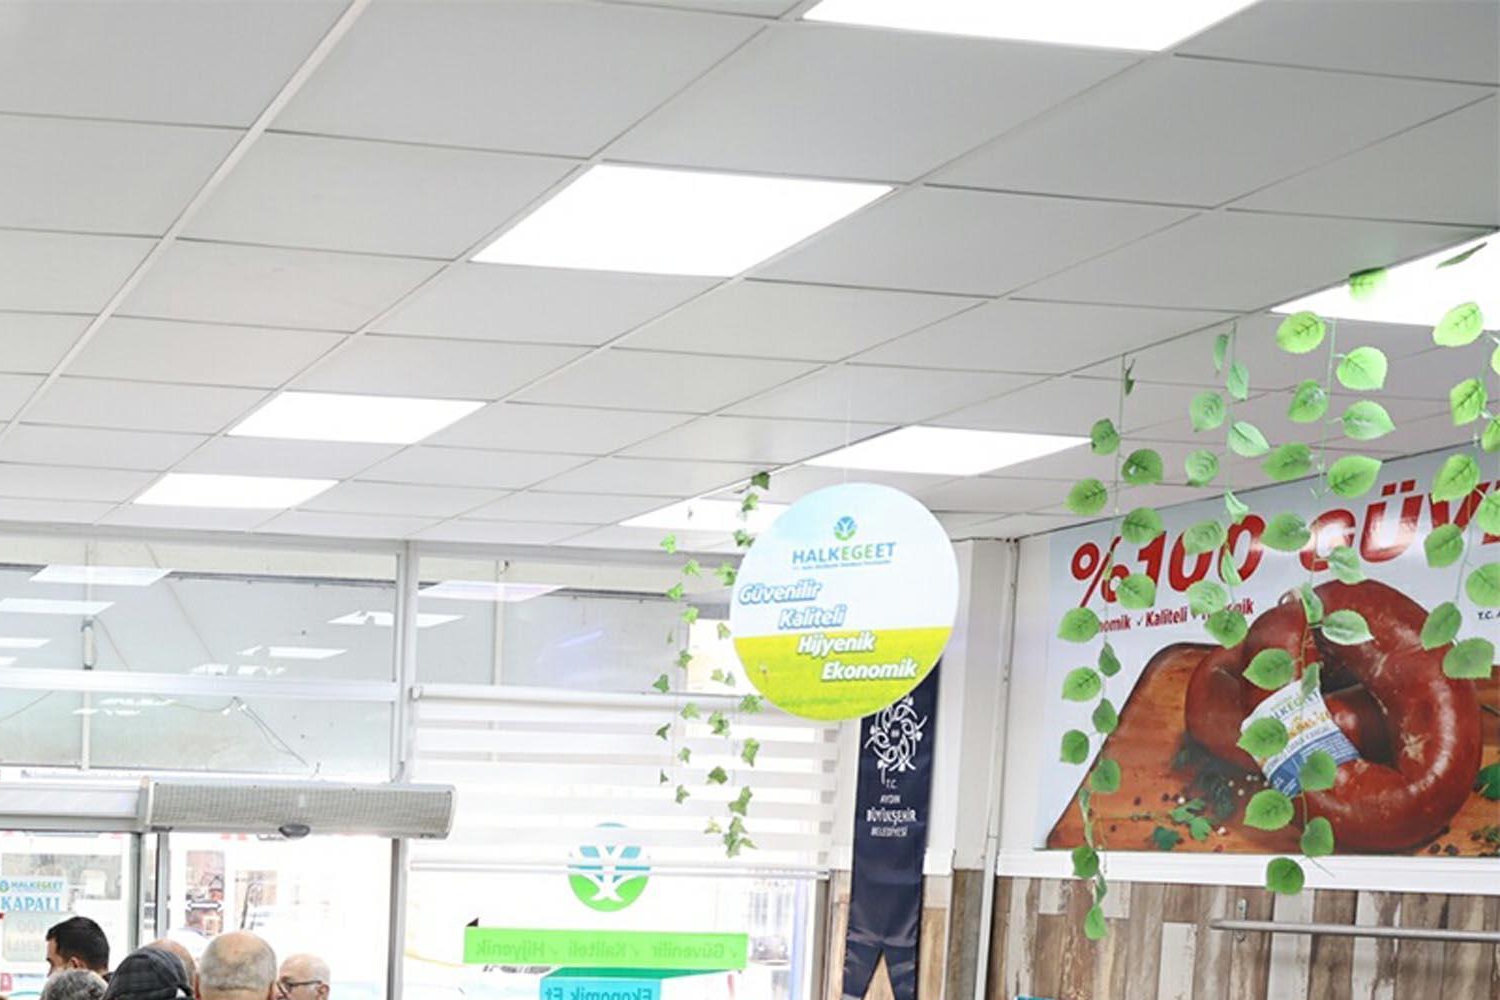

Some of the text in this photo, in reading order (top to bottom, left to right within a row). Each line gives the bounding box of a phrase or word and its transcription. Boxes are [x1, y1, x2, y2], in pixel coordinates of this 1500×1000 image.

[791, 541, 898, 564] HALKEGEET
[738, 577, 823, 604] Güvenilir
[778, 604, 848, 630] Kaliteli
[1144, 605, 1188, 628] Kaliteli
[796, 630, 877, 659] Hijyenik
[820, 658, 920, 682] Ekonomik
[865, 806, 918, 826] BÜYÜKŞEHİR
[0, 895, 61, 912] KAPALI
